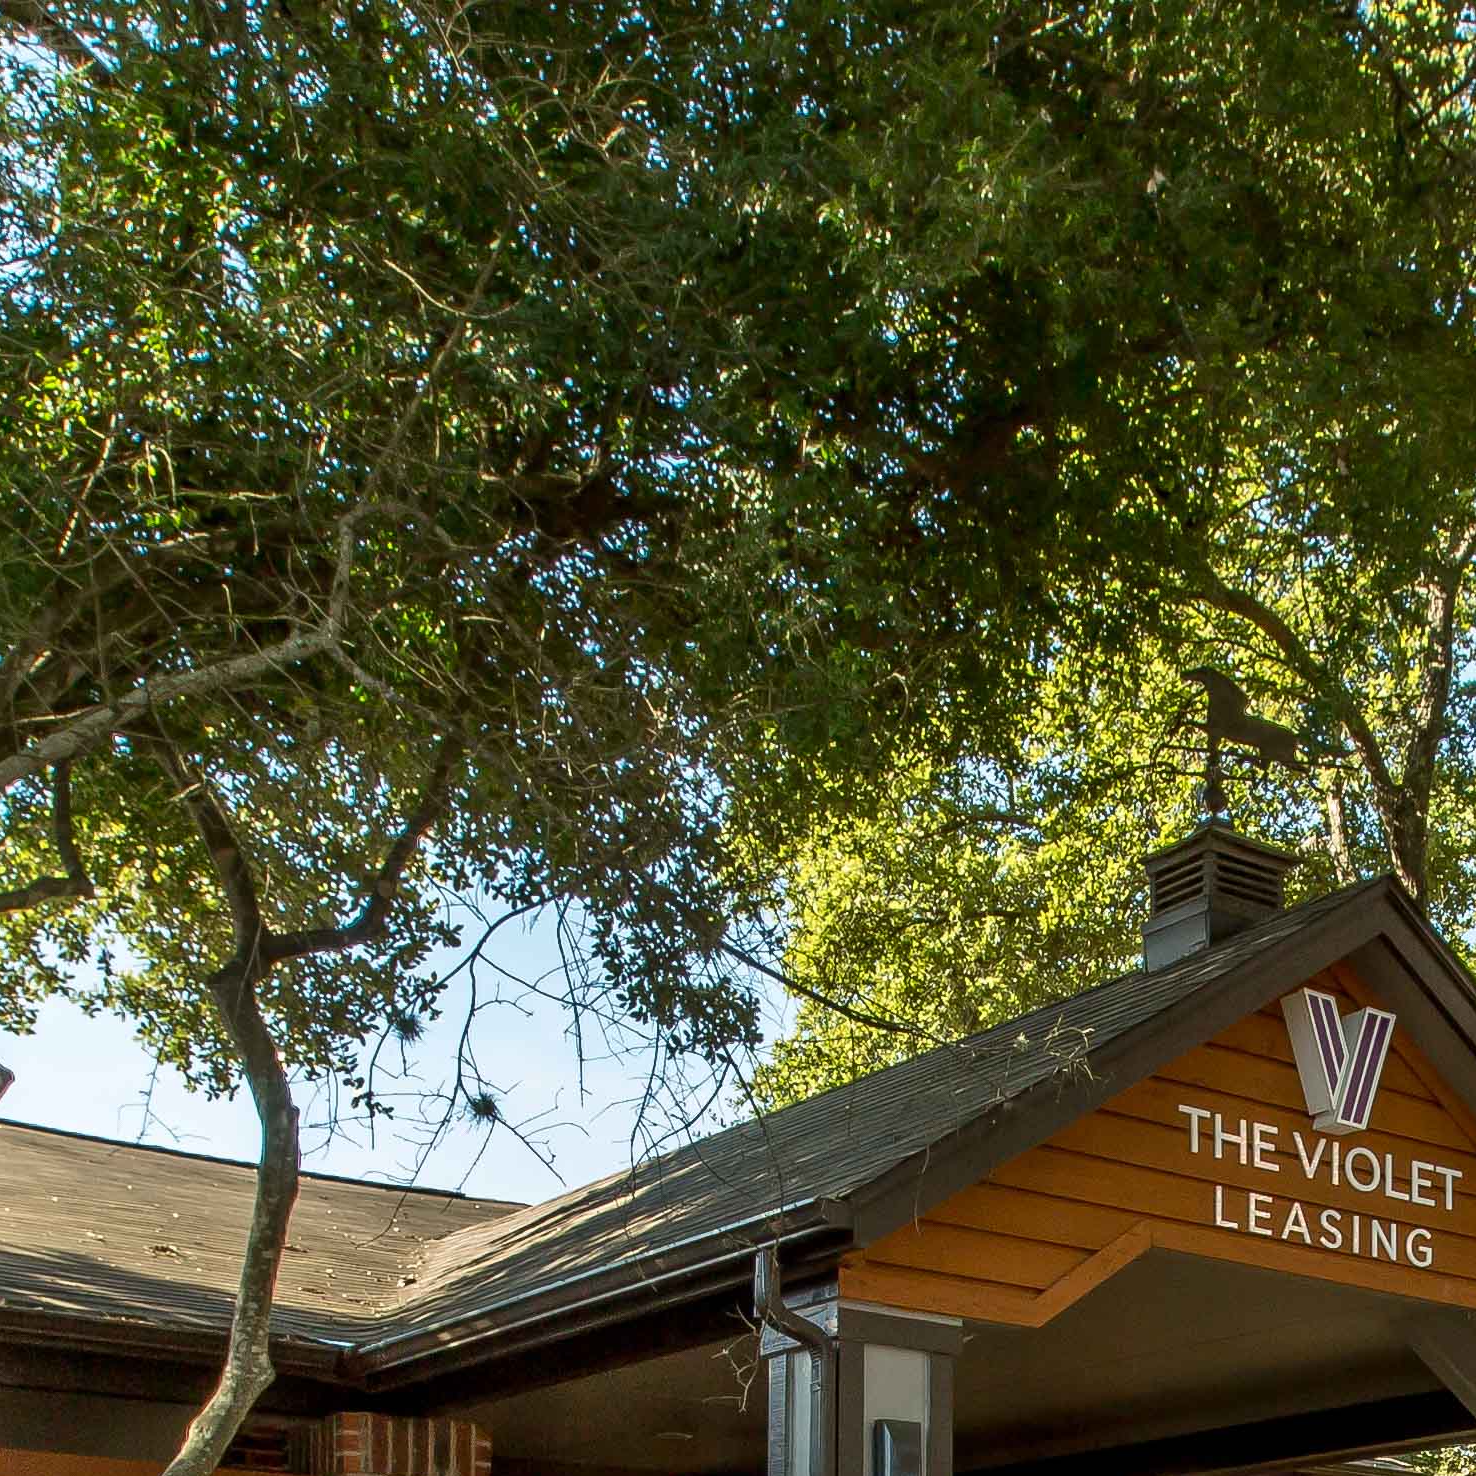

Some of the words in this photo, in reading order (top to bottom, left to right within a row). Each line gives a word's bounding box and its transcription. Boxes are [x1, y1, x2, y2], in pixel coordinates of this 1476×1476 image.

[1178, 1104, 1281, 1173] THE
[1292, 1131, 1463, 1211] VIOLET
[1214, 1184, 1434, 1268] LEASING
